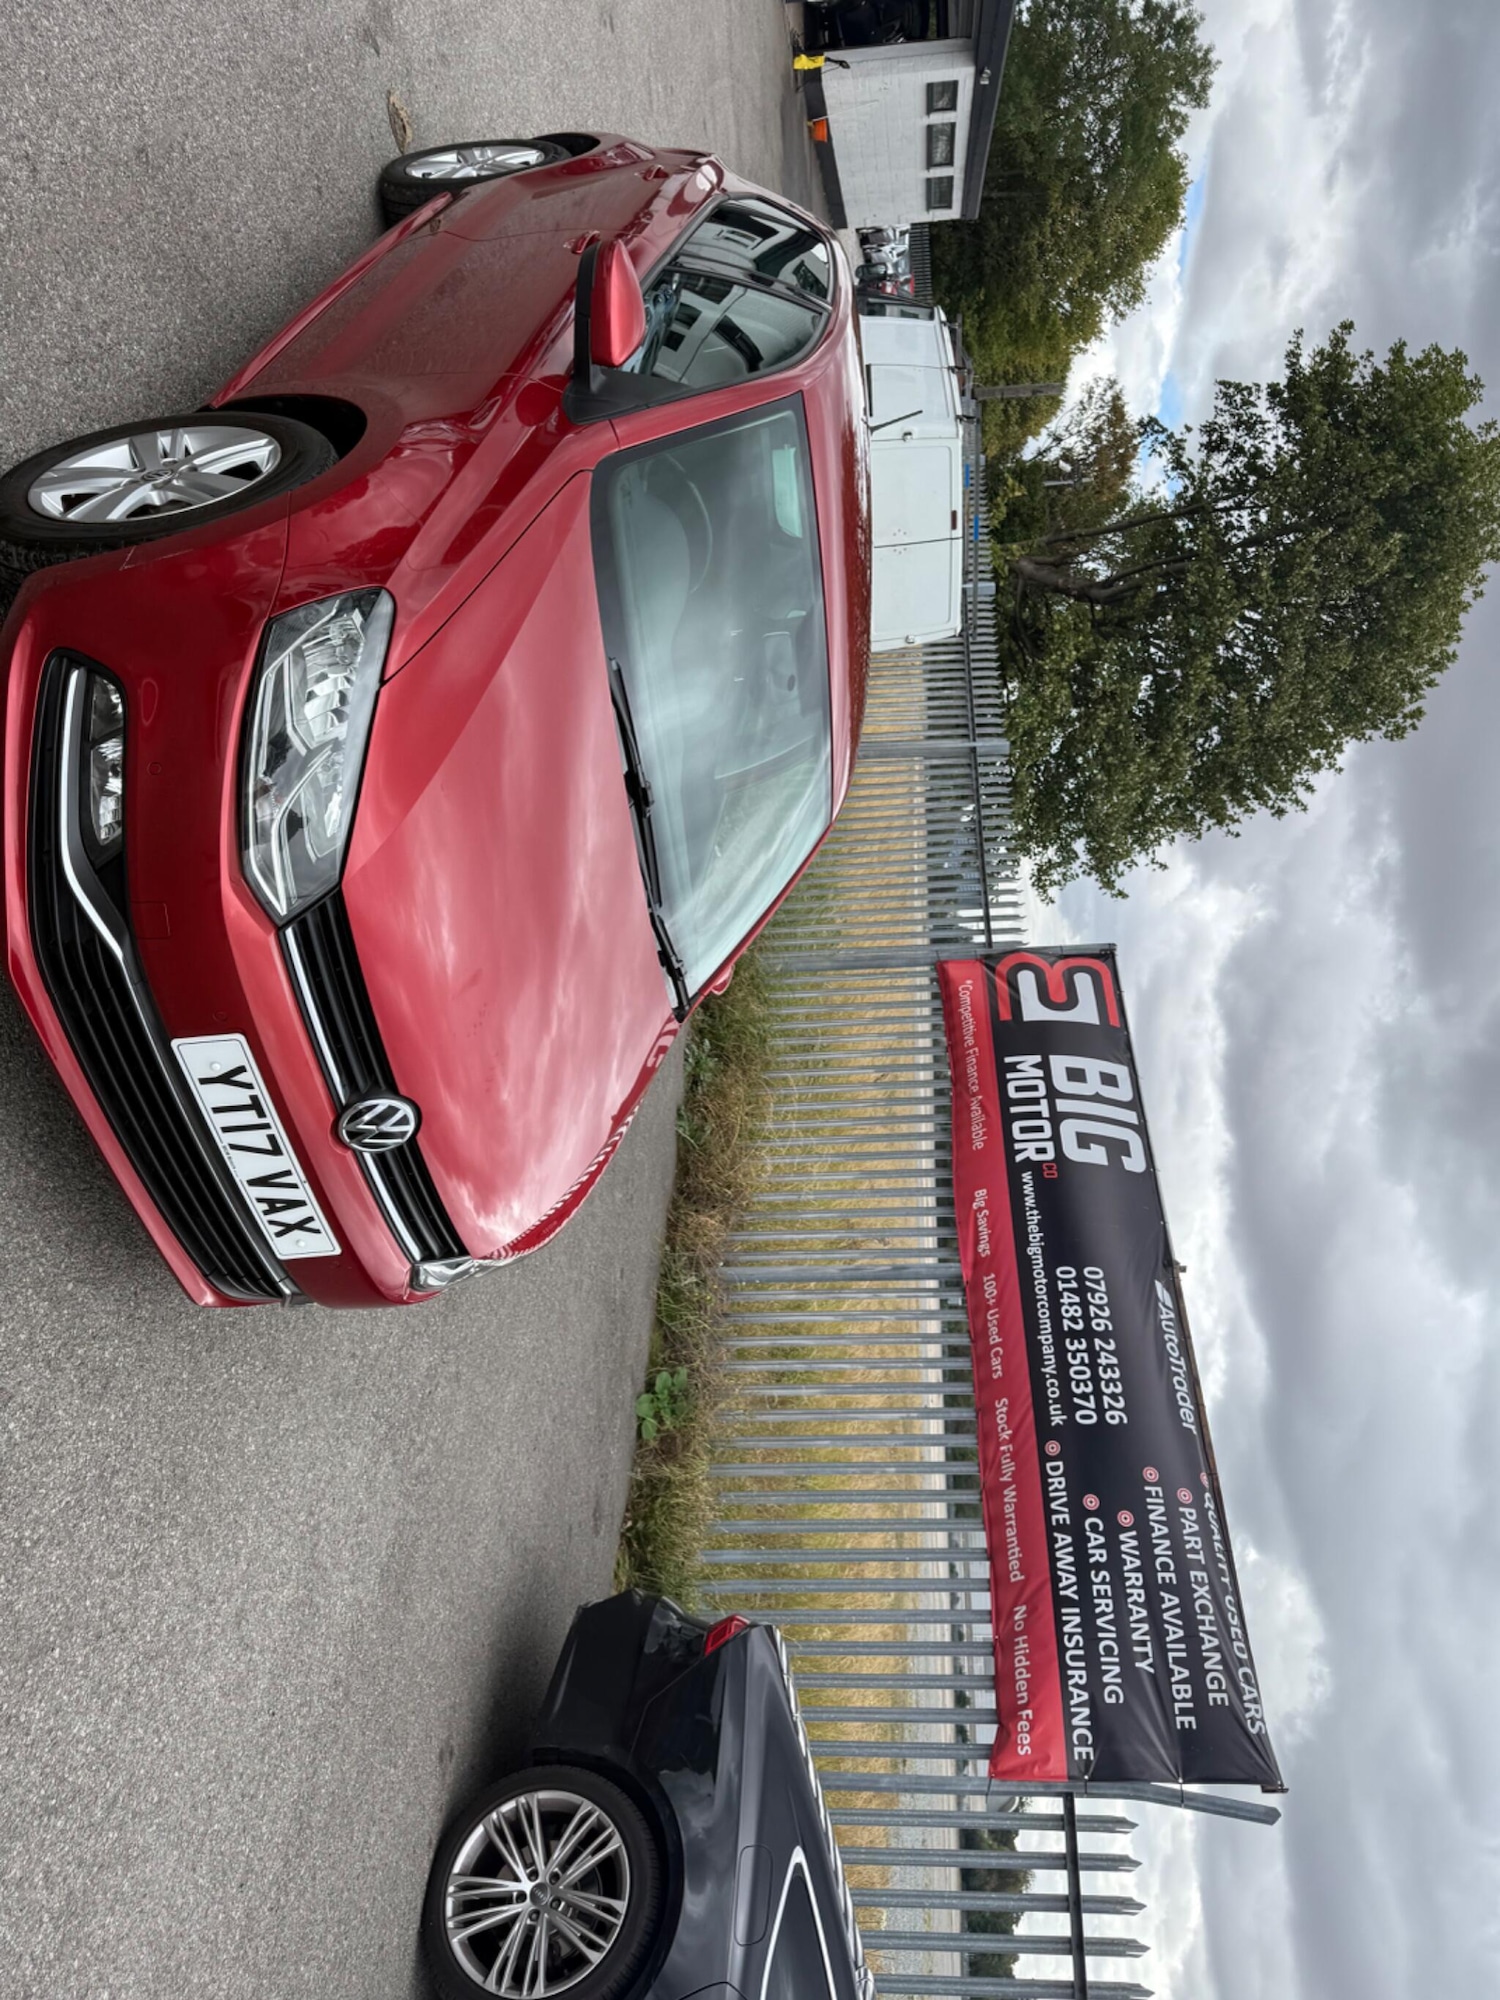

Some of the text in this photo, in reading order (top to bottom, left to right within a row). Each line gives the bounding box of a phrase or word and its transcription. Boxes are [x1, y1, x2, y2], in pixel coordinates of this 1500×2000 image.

[965, 1047, 980, 1093] Finance
[969, 1095, 988, 1151] Available
[1003, 1054, 1058, 1179] MOTOR CO
[1049, 1055, 1146, 1173] BIG
[198, 1065, 322, 1239] YT17 VAX
[972, 1188, 993, 1258] Big Savings
[982, 1273, 1005, 1379] 100+ Used Cars
[1021, 1171, 1067, 1426] www.thebigmotorcompany.co.uk
[1055, 1266, 1097, 1425] 01482 350370
[1083, 1266, 1128, 1425] 07926 243326
[1158, 1302, 1197, 1435] AutoTrader
[994, 1398, 1025, 1583] Stock Fully Warrantied
[1012, 1605, 1033, 1756] No Hidden Fees
[1045, 1461, 1094, 1761] DRIVE AWAY INSURANCE
[1084, 1517, 1124, 1704] CAR SERVICING
[1118, 1530, 1155, 1674] WARRANTY
[1143, 1485, 1197, 1730] FINANCE AVAILABLE
[1178, 1507, 1229, 1706] PART EXCHANGE
[1204, 1492, 1266, 1735] QUALITY USED CARS
